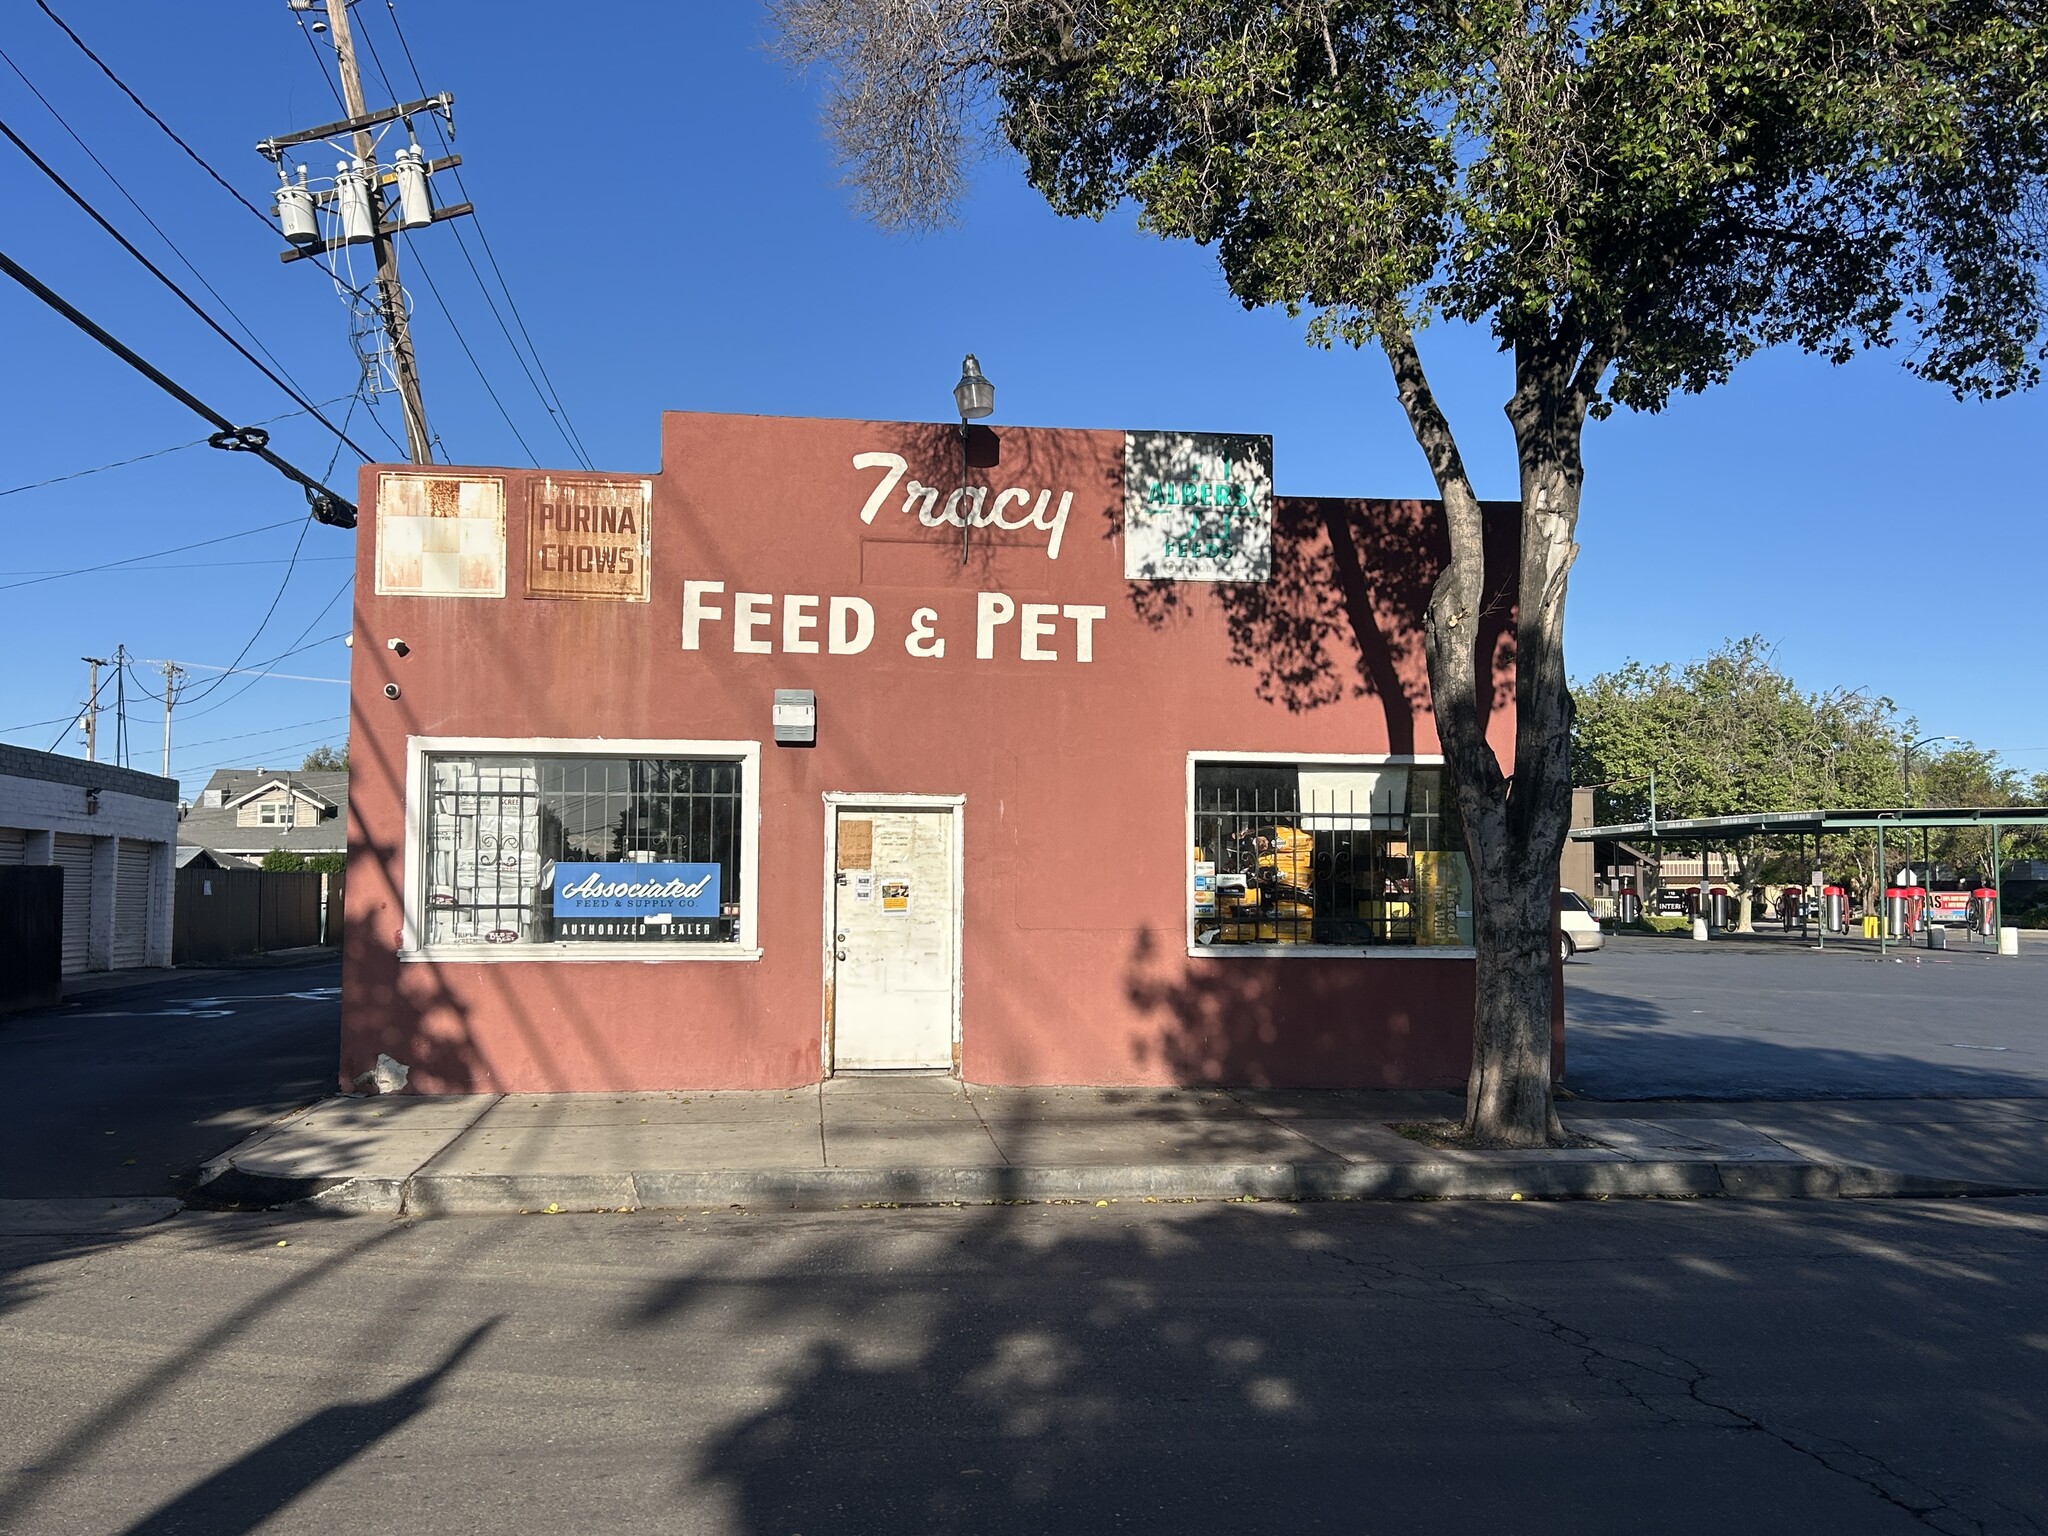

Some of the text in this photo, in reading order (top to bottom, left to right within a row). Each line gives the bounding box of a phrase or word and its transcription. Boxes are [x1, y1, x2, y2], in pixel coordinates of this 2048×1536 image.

[852, 452, 1073, 560] Tracy
[1146, 482, 1248, 507] ALBERS
[539, 503, 636, 535] PURINA
[541, 543, 634, 575] CHOWS
[1163, 542, 1234, 559] FEEDS
[680, 579, 1107, 663] FEED & PET
[501, 798, 520, 806] SCREE
[562, 872, 712, 899] Associated
[576, 899, 698, 908] FEED & SUPPLY CO.
[1434, 886, 1446, 939] the Wild
[1447, 886, 1459, 939] Taste of
[562, 923, 711, 936] AUTHORIZED DEALER
